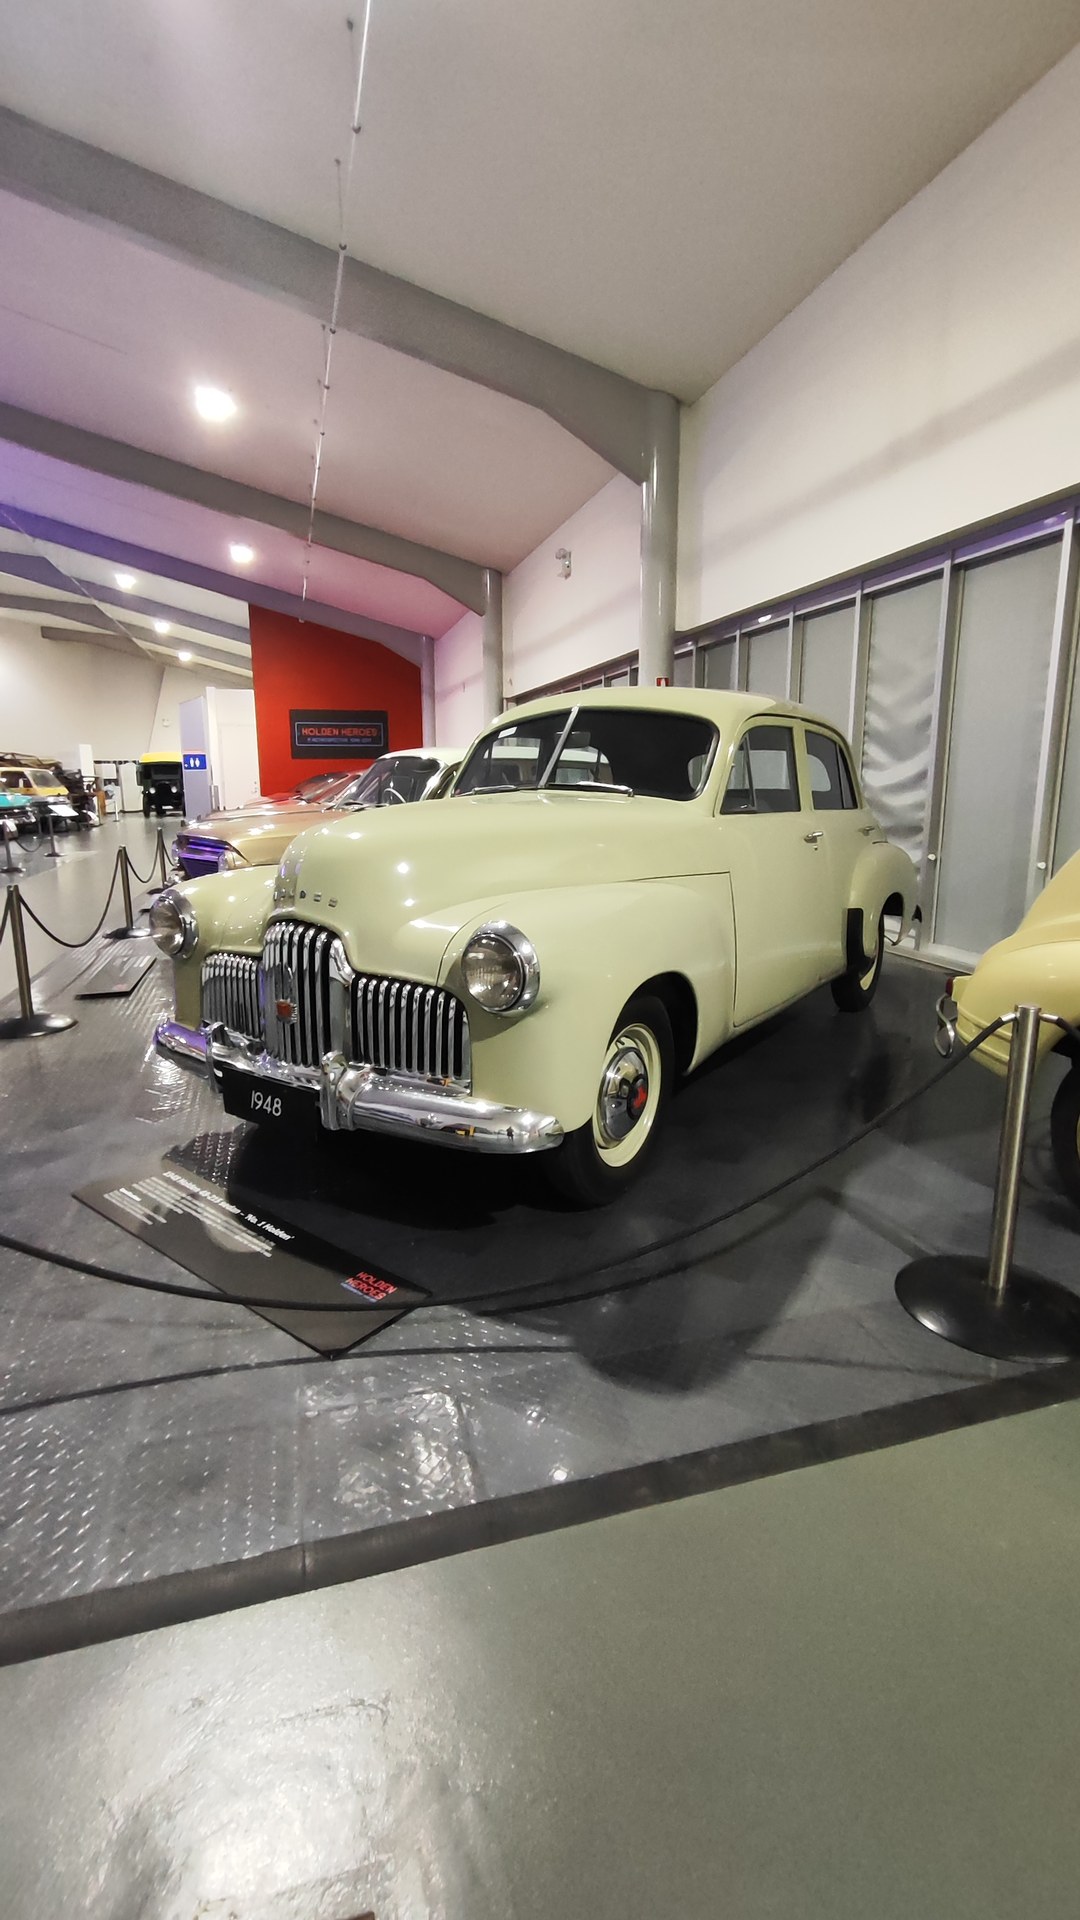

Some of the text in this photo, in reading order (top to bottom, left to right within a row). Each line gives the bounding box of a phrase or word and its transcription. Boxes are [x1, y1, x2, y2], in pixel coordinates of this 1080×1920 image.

[301, 727, 378, 737] HOLDEN HEROES
[250, 1090, 282, 1117] 1948
[344, 1277, 387, 1300] HEROES
[355, 1271, 398, 1294] HOLDEN
